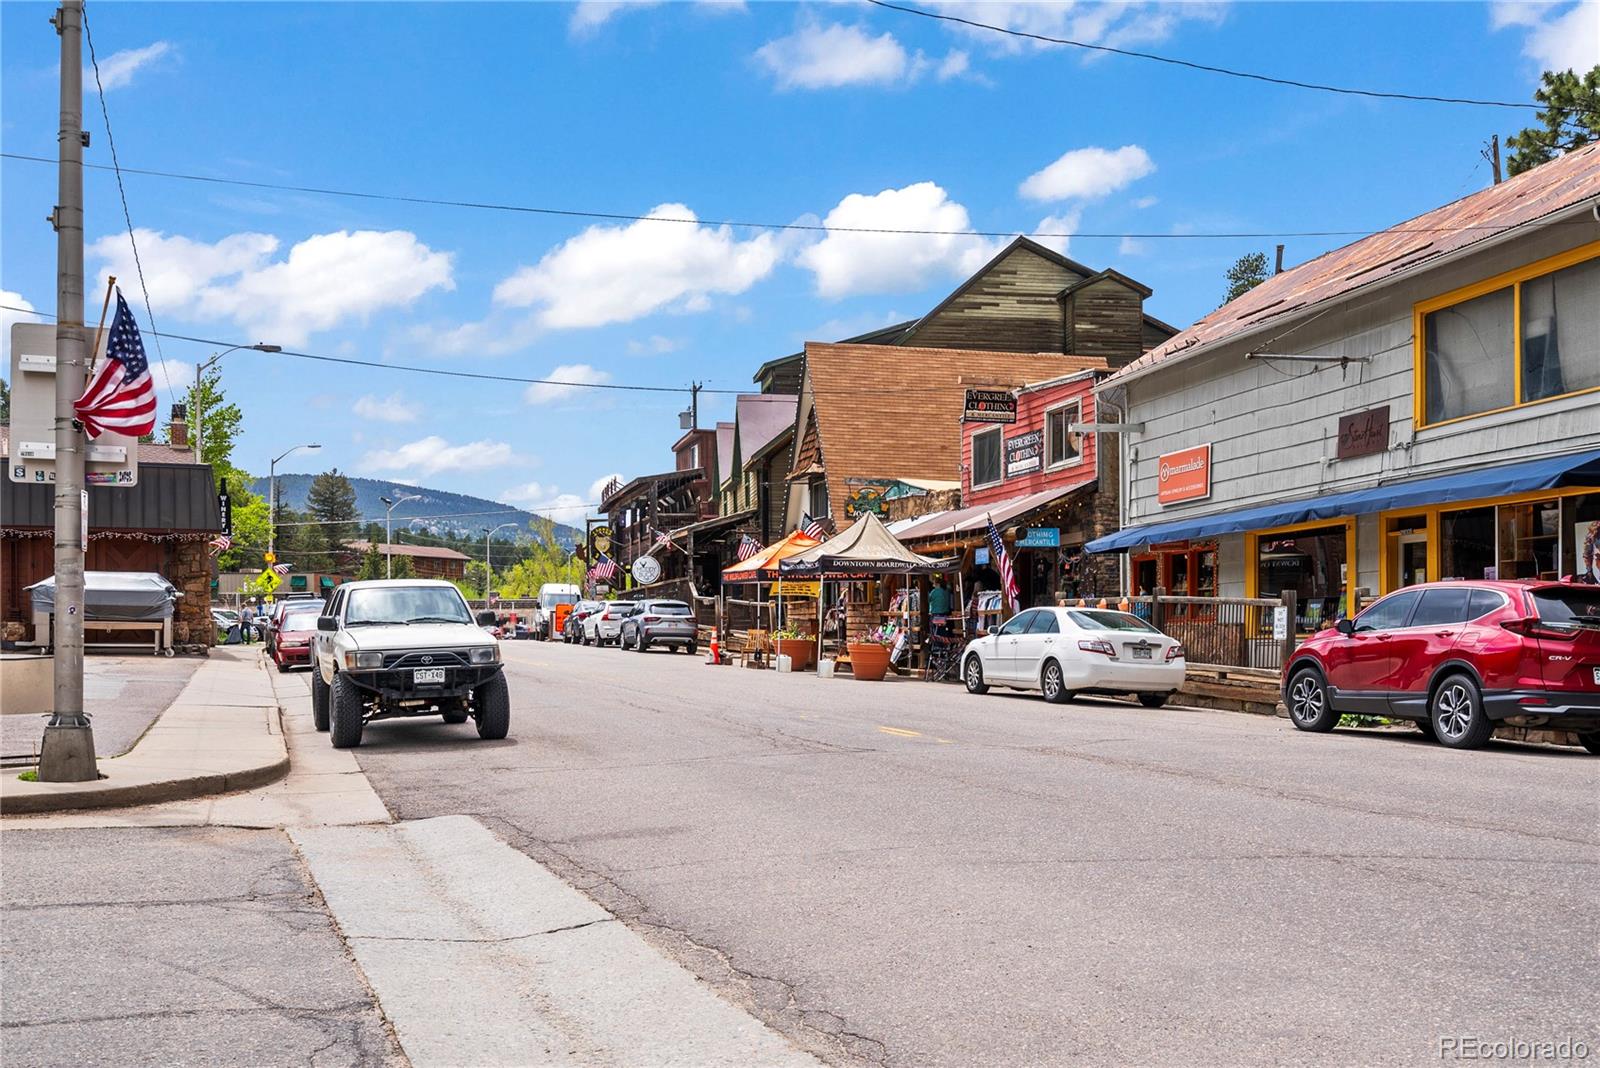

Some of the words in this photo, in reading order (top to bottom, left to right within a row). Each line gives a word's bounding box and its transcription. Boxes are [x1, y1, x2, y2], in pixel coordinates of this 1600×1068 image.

[968, 401, 1015, 411] CLOTHING
[1007, 433, 1041, 451] EVERGREEN
[1169, 456, 1205, 476] marmalade
[833, 560, 875, 568] DOWNTOWN
